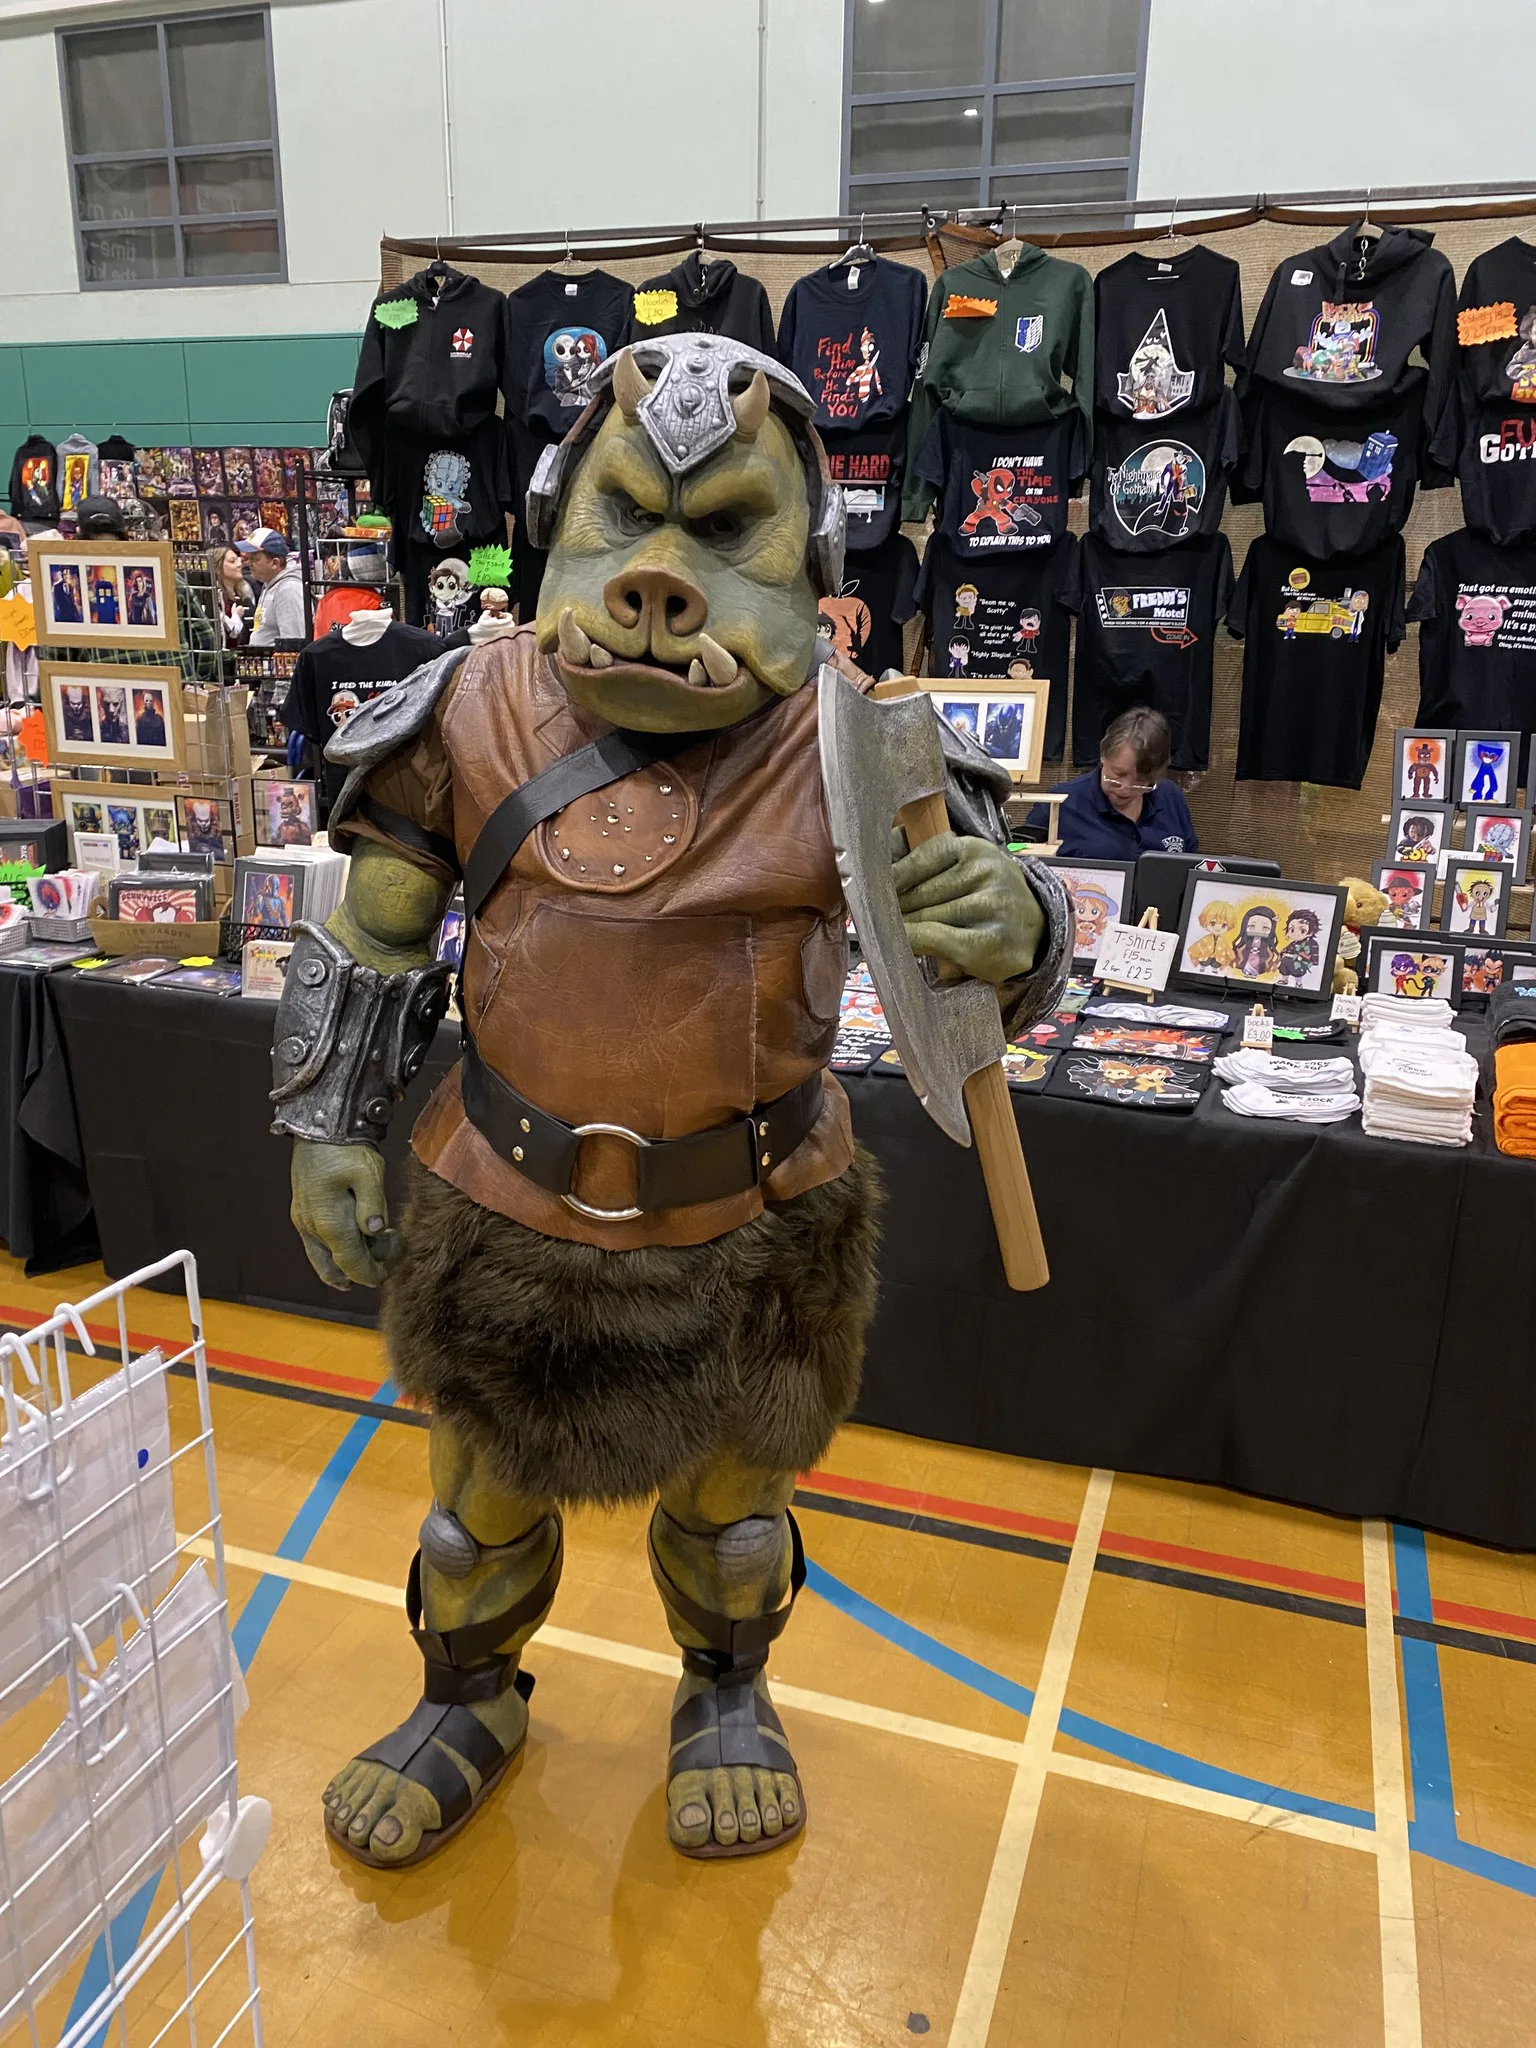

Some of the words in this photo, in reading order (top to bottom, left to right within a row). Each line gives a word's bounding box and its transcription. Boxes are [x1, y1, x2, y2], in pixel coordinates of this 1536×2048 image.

[817, 332, 853, 358] Find
[830, 352, 856, 370] Him
[813, 368, 847, 380] Before
[825, 379, 839, 392] He
[820, 387, 855, 404] Finds
[827, 402, 859, 418] YOU
[828, 454, 845, 479] IE
[848, 453, 890, 479] HARD
[992, 457, 997, 468] I
[996, 455, 1022, 468] DON'T
[1022, 455, 1044, 467] HAVE
[1014, 467, 1035, 476] THE
[1119, 464, 1161, 484] Nightmare
[1016, 475, 1053, 487] TIME
[1122, 481, 1154, 496] Gotham
[1012, 495, 1059, 505] CRAYONS
[969, 537, 979, 547] TO
[979, 536, 1007, 546] EXPLAIN
[1007, 535, 1024, 545] THIS
[1025, 535, 1037, 545] TO
[1036, 534, 1052, 544] YOU
[476, 551, 498, 560] SALE
[475, 570, 491, 582] £10
[1458, 584, 1478, 593] Just
[1479, 585, 1495, 594] got
[1132, 589, 1187, 609] FREDDY'S
[1153, 607, 1185, 618] Motel
[1503, 619, 1520, 630] It's
[331, 681, 338, 690] I
[338, 681, 357, 689] NEED
[357, 681, 374, 689] THE
[375, 680, 398, 688] KINDA
[233, 792, 241, 825] FRAGILE
[1114, 930, 1166, 951] T-shirts
[1122, 948, 1140, 960] £15
[1102, 959, 1110, 971] 2
[1126, 965, 1153, 980] £25
[1247, 1018, 1270, 1027] Socks
[1247, 1028, 1271, 1040] £3.00
